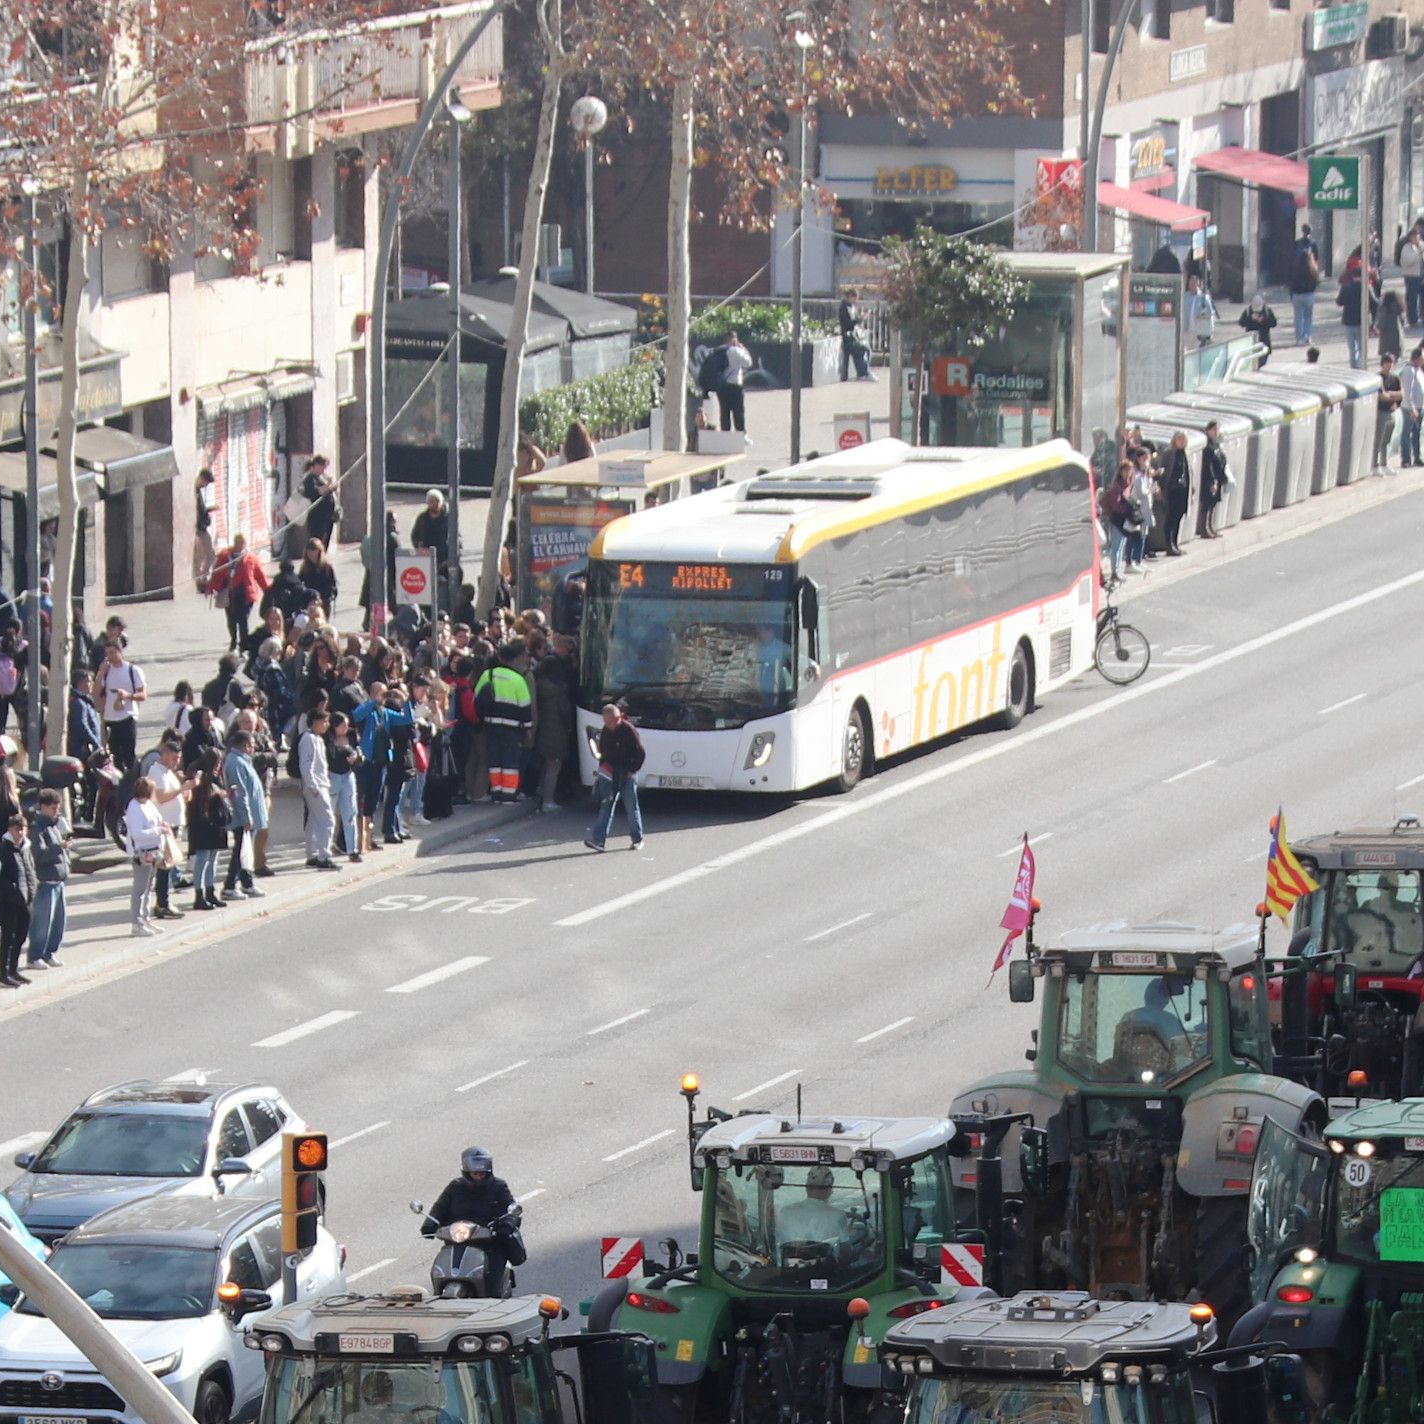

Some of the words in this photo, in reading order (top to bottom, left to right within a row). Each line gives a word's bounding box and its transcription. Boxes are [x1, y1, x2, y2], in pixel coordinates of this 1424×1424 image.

[876, 165, 957, 190] ELTER
[1314, 187, 1353, 201] adif
[946, 362, 969, 387] R
[974, 373, 1044, 390] Rodalies
[532, 531, 576, 545] CELEBRA
[533, 544, 545, 557] EL
[619, 563, 645, 588] E4
[677, 565, 727, 578] EXPRES
[763, 569, 783, 581] 129
[672, 577, 734, 590] RIPOLLET
[913, 619, 1006, 746] font
[359, 893, 538, 915] BUS
[1349, 1163, 1366, 1182] 50
